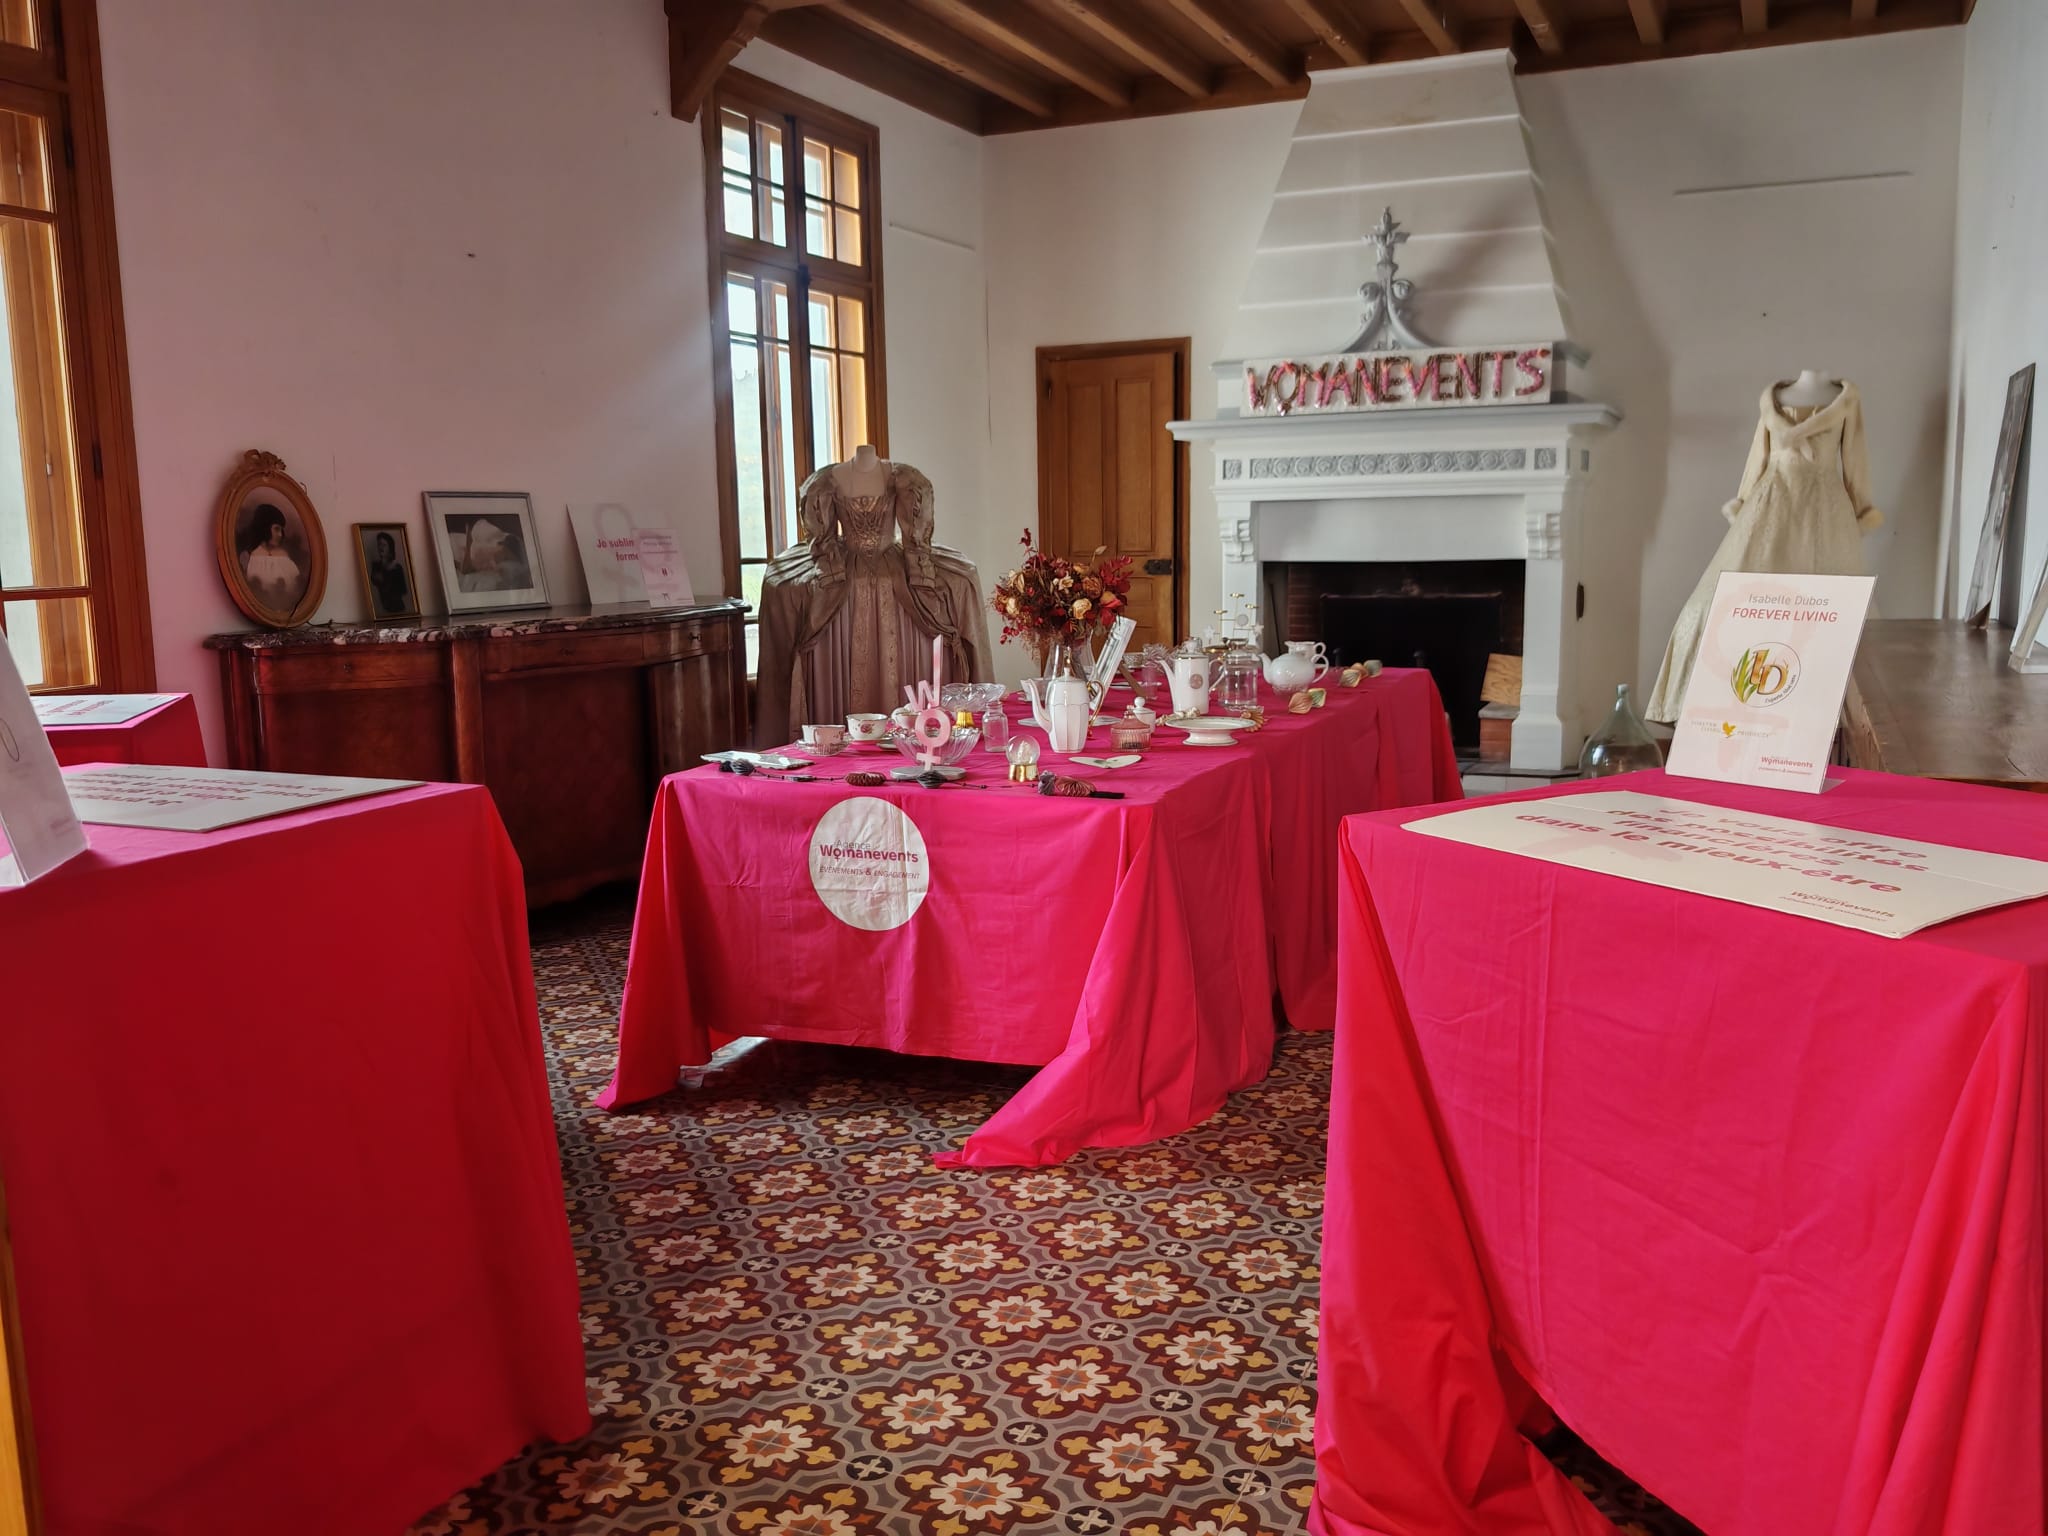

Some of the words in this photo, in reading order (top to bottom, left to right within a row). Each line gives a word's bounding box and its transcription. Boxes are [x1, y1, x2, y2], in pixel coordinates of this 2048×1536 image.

[1247, 348, 1550, 412] WOMANEVENTS
[597, 539, 607, 549] Je
[1748, 593, 1791, 606] Isabelle
[1795, 595, 1829, 607] Dubos
[1732, 607, 1791, 622] FOREVER
[1793, 609, 1838, 623] LIVING
[1605, 810, 1673, 823] des
[1676, 823, 1929, 872] possibilités
[1613, 820, 1845, 867] financières
[1658, 809, 1706, 818] Je
[1718, 818, 1808, 837] vous
[1820, 837, 1927, 859] offre
[819, 844, 919, 863] Womanevents
[836, 840, 871, 850] Agence
[1515, 814, 1605, 833] dans
[1610, 830, 1650, 842] le
[1656, 840, 1902, 893] mieux-être
[873, 870, 920, 880] ENGAGEMENT
